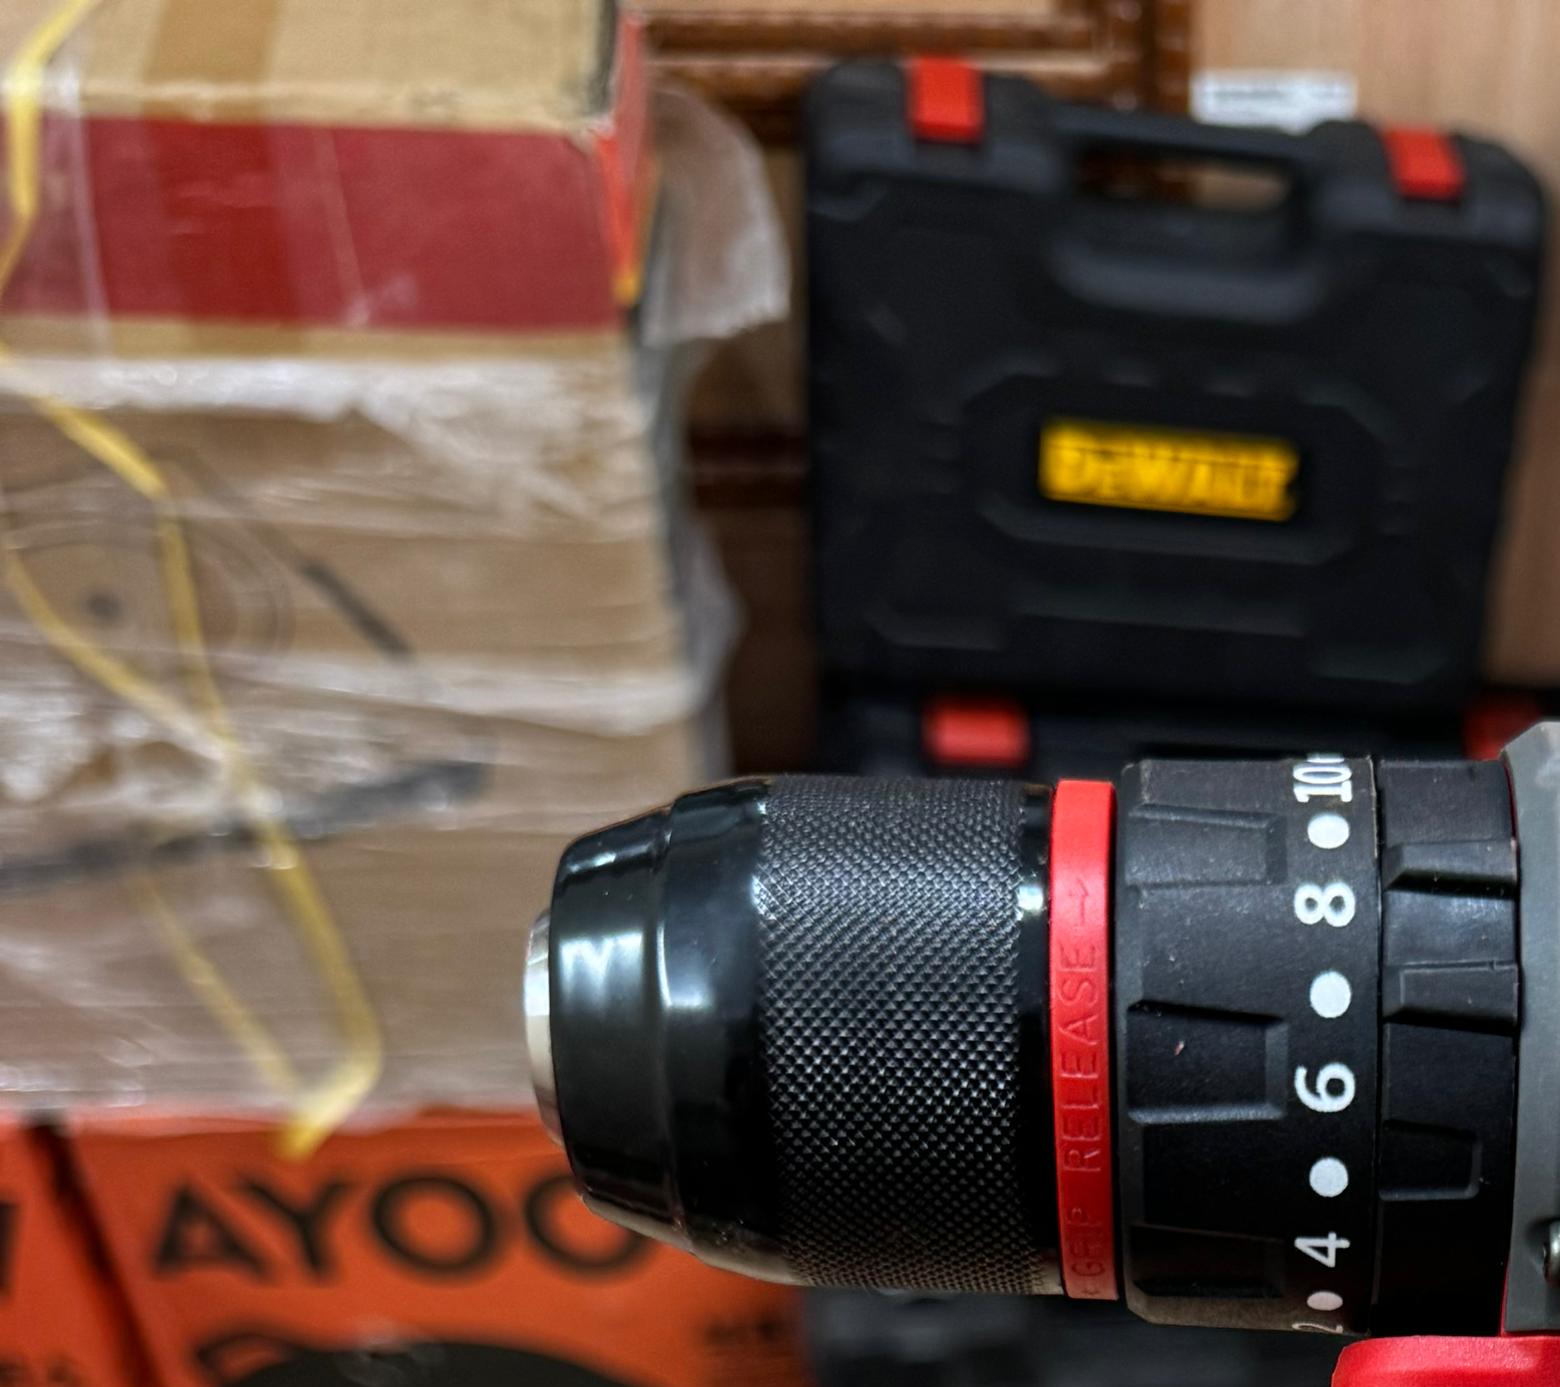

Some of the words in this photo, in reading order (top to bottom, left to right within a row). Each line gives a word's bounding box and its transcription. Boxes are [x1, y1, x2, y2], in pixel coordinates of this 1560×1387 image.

[1293, 764, 1352, 803] 10
[1293, 882, 1356, 927] 8
[1058, 944, 1101, 1172] RELEASE
[1293, 1062, 1356, 1113] 6
[1294, 1231, 1351, 1268] 4
